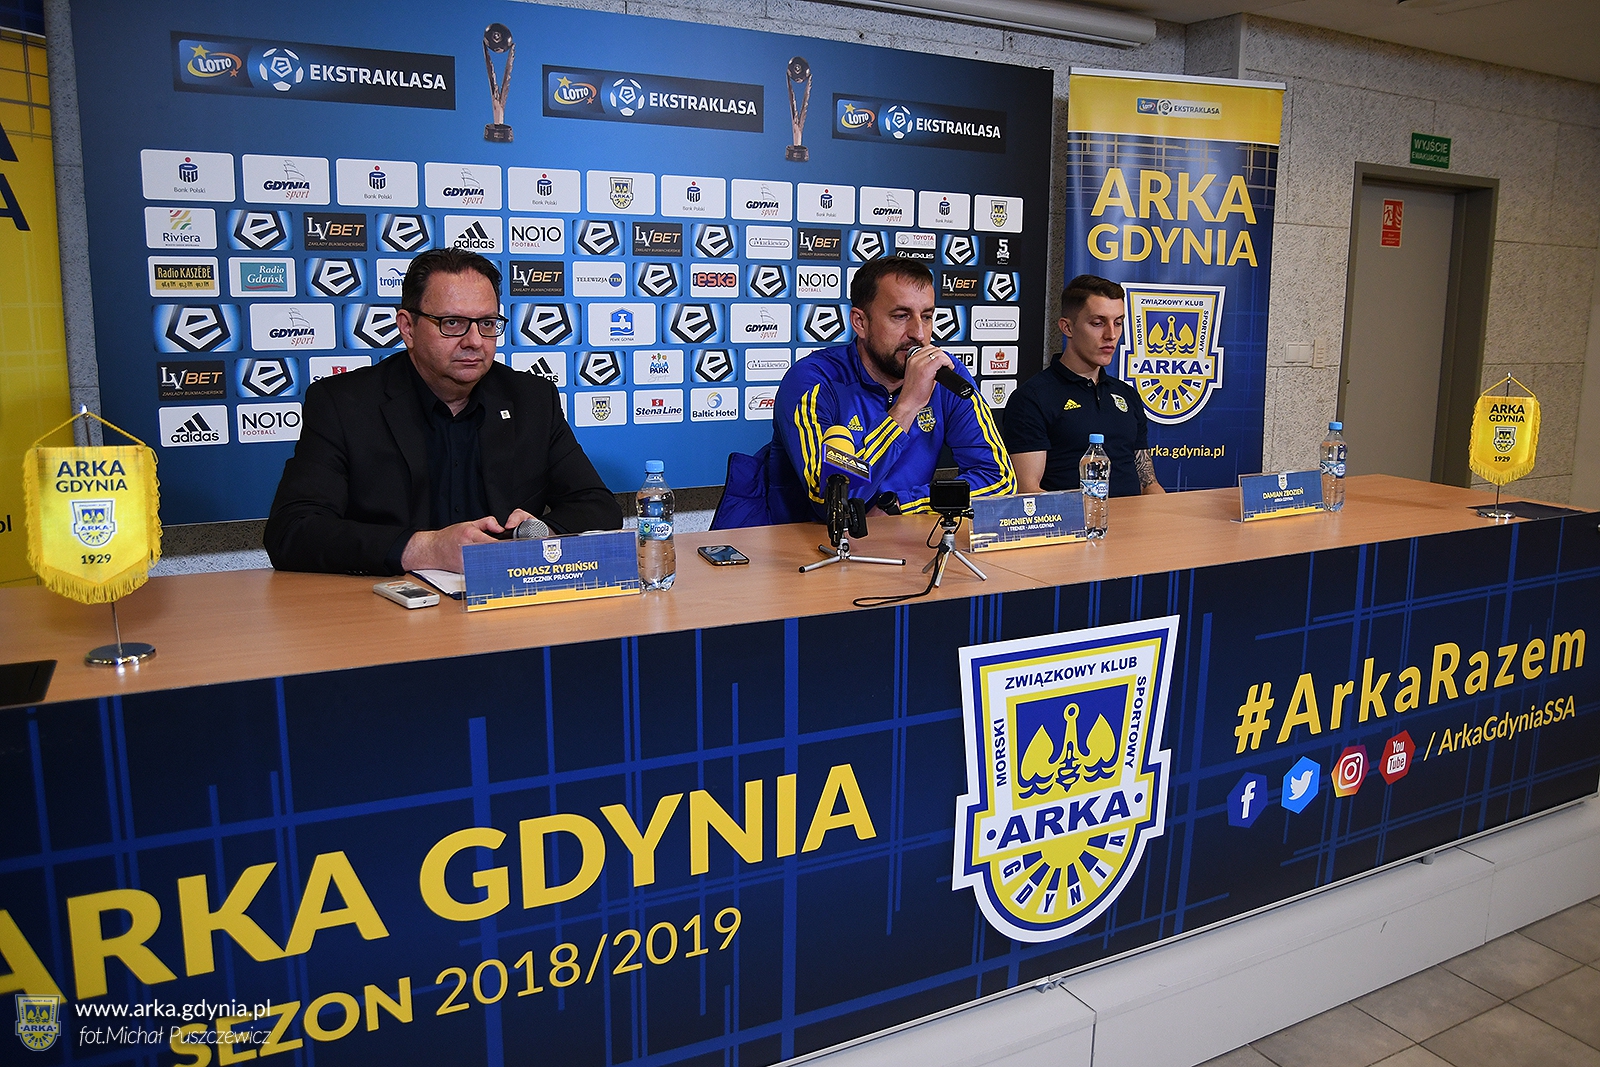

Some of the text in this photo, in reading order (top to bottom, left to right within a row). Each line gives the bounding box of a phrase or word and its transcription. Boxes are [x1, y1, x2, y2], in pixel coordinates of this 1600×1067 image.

[198, 57, 446, 90] LOTTO EKSTRAKLASA
[562, 86, 758, 116] LOTTO EKSTRAKLASA
[1174, 104, 1220, 114] EKSTRAKLASA
[847, 112, 1002, 139] LOTTO EKSTRAKLASA
[1414, 138, 1448, 153] WYJŚCIE
[263, 180, 310, 191] GDYNIA
[442, 187, 484, 197] GDYNIA
[286, 188, 310, 200] sport
[462, 195, 484, 206] sport
[1090, 168, 1258, 224] ARKA
[745, 200, 779, 209] GDYNIA
[760, 208, 778, 217] sport
[872, 207, 903, 216] GDYNIA
[162, 232, 201, 242] Riviera
[512, 226, 562, 242] NO10
[454, 238, 494, 250] adidas
[1087, 223, 1258, 267] GDYNIA
[158, 267, 179, 278] Radio
[259, 265, 284, 273] Radio
[247, 274, 284, 283] Gdańsk
[379, 276, 403, 288] trojm
[697, 273, 736, 287] eska
[799, 273, 838, 287] NO10
[1140, 298, 1183, 307] ZWIĄZKOWY
[269, 328, 315, 338] GDYNIA
[745, 324, 778, 332] GDYNIA
[1199, 310, 1209, 352] SPORTOWY
[290, 336, 314, 346] sport
[760, 331, 778, 339] sport
[1138, 360, 1204, 375] ARKA
[759, 399, 775, 408] FR
[1490, 404, 1525, 414] ARKA
[636, 406, 682, 416] Stena Line
[692, 409, 737, 418] Baltic Hotel
[242, 411, 300, 430] NO10
[1489, 414, 1525, 423] GDYNIA
[170, 430, 220, 443] adidas
[1148, 444, 1225, 459] rka.gdynia.pl
[56, 460, 126, 478] ARKA
[56, 478, 128, 493] GDYNIA
[1263, 491, 1283, 499] DAMIAN
[1000, 514, 1062, 527] ZBIGNIEW SMÓŁKA
[651, 524, 669, 532] Kropla
[81, 554, 112, 564] 1929
[507, 560, 598, 578] TOMASZ RYBIŃSKI
[522, 572, 584, 584] RZECZNIK PRASOWY
[1004, 655, 1138, 690] ZWIĄZKOWY KLUB
[1234, 628, 1586, 754] #ArkaRazem
[1124, 675, 1147, 769] SPORTOWY
[1438, 695, 1576, 756] ArkaGdyniaSSA
[993, 718, 1007, 787] MORSKI
[1392, 740, 1405, 754] You
[1387, 756, 1406, 773] Tube
[996, 790, 1131, 851] ARKA
[1003, 833, 1125, 913] GDYNIA
[0, 763, 877, 1004] ARKA GDYNIA
[168, 907, 742, 1067] SEZON 2018/2019
